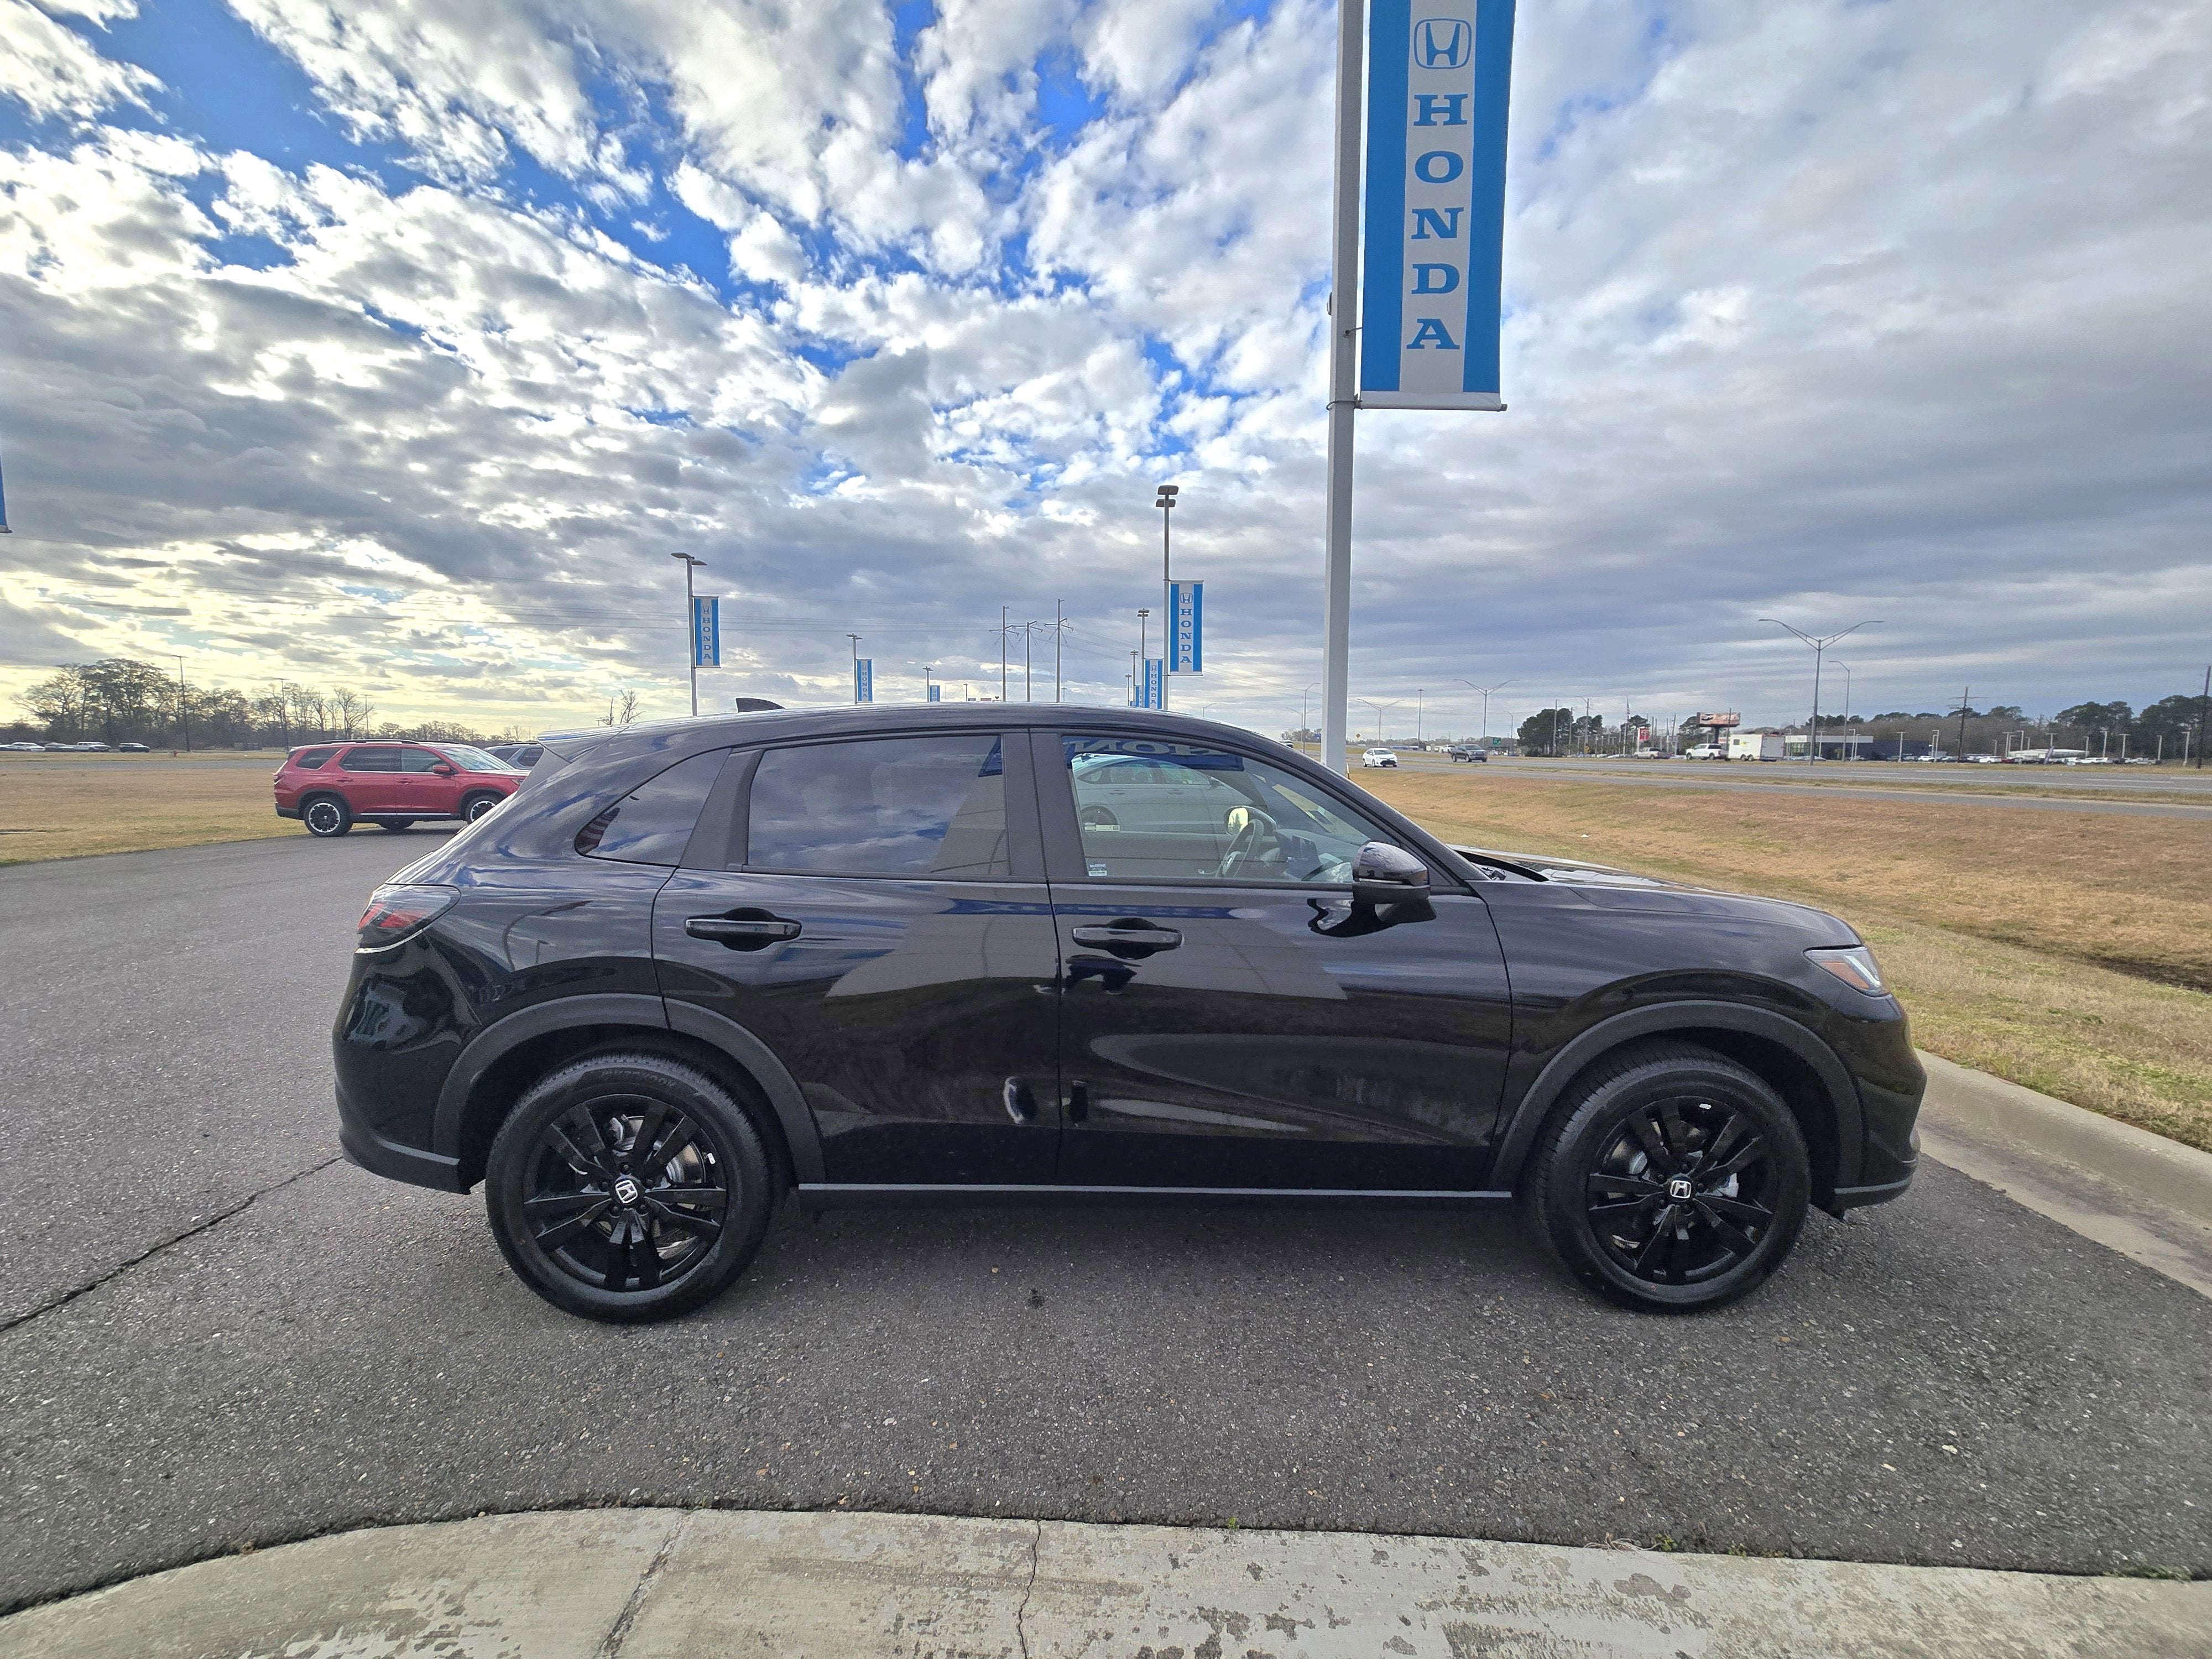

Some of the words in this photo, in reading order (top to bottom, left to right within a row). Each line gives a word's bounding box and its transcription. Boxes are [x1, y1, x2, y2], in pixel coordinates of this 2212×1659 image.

[1406, 93, 1468, 349] HONDA
[702, 617, 712, 659] HONDA
[1180, 608, 1192, 663] HONDA
